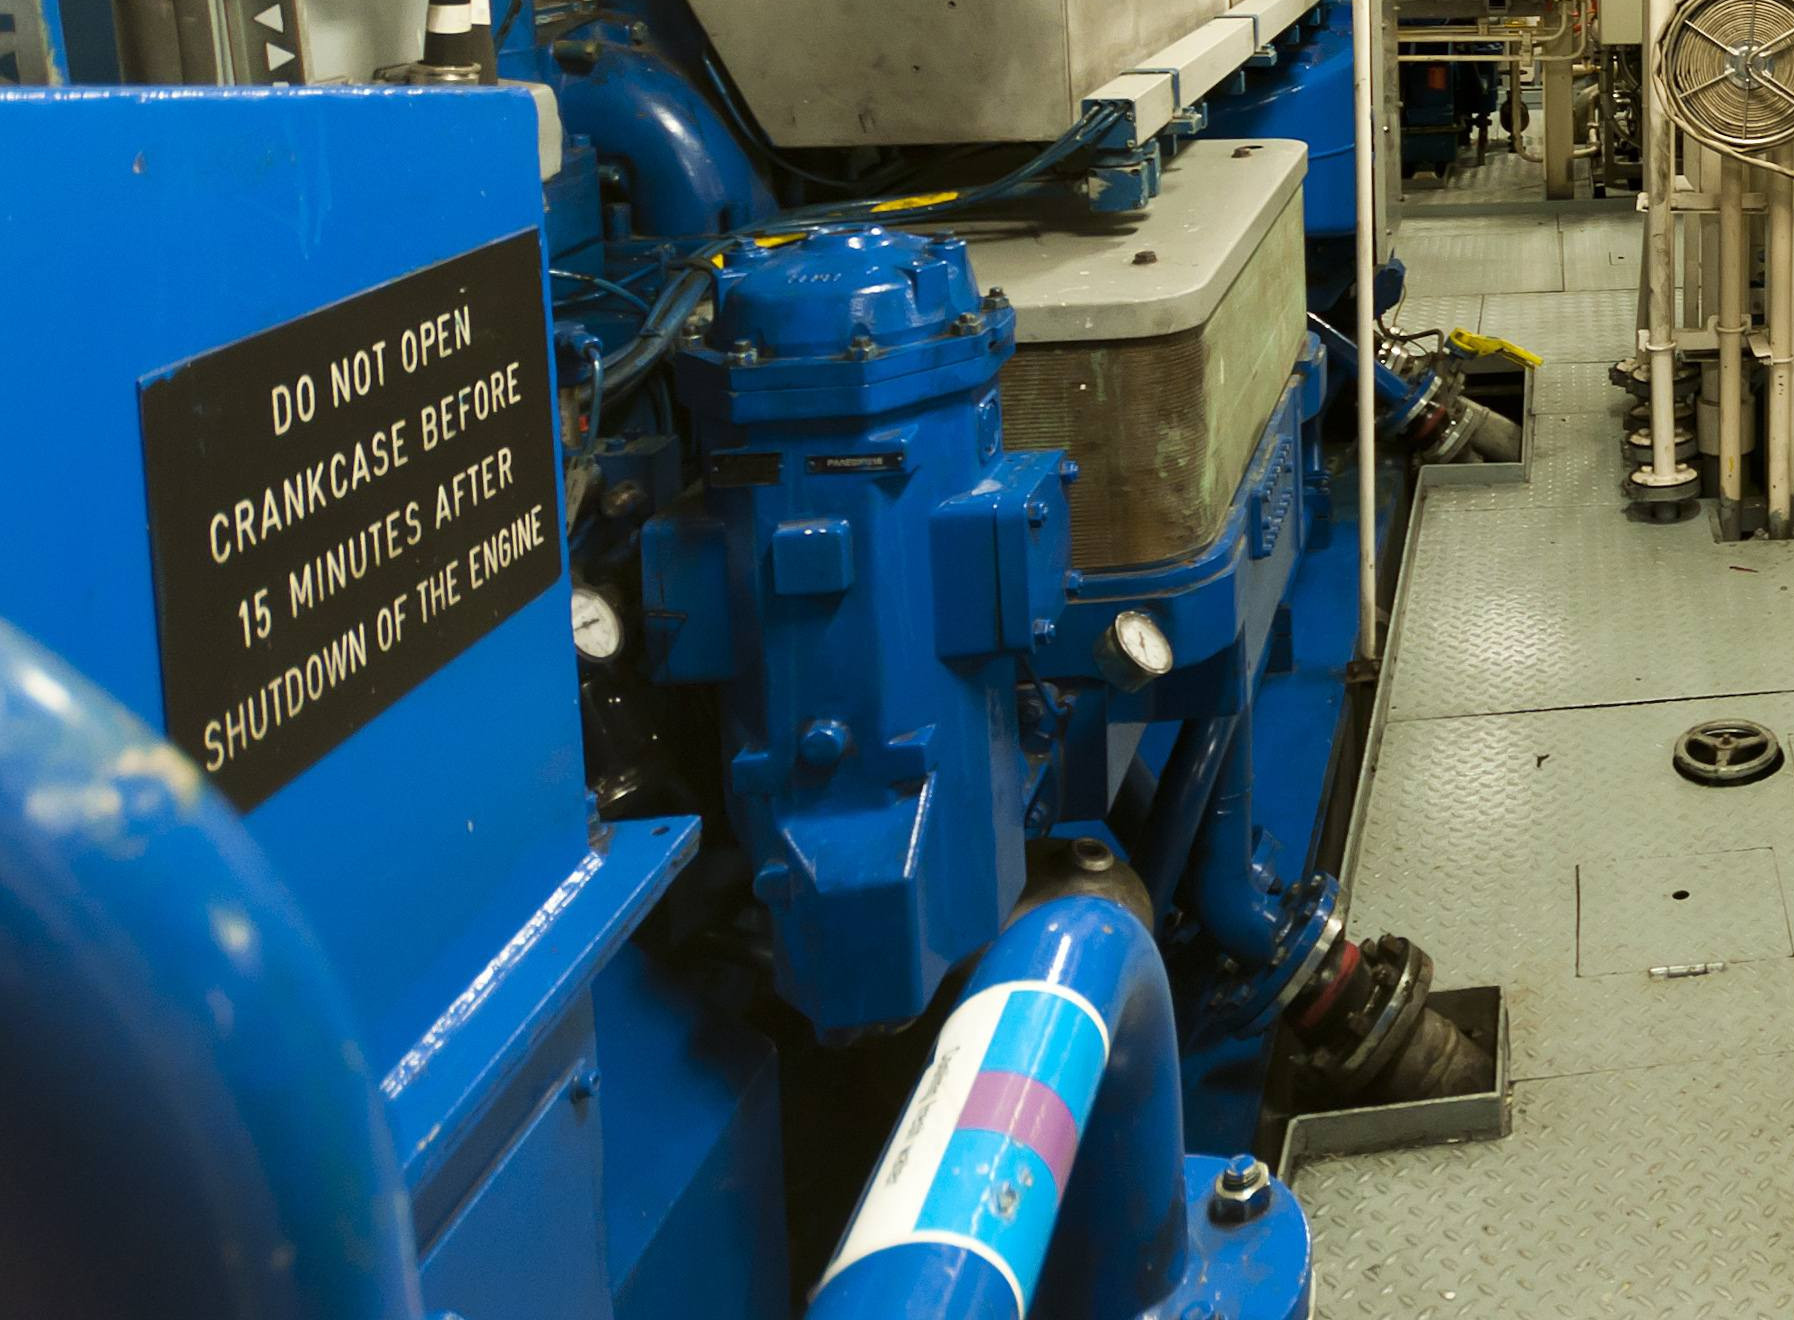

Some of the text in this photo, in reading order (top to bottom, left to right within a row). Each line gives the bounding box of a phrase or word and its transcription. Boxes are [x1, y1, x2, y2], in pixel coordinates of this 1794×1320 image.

[210, 361, 521, 564] CRANKCASE BEFORE
[271, 305, 472, 436] DO NOT OPEN
[204, 504, 546, 772] SHUTDOWN OF THE ENGINE
[238, 447, 513, 647] 15 MINUTES AFTER
